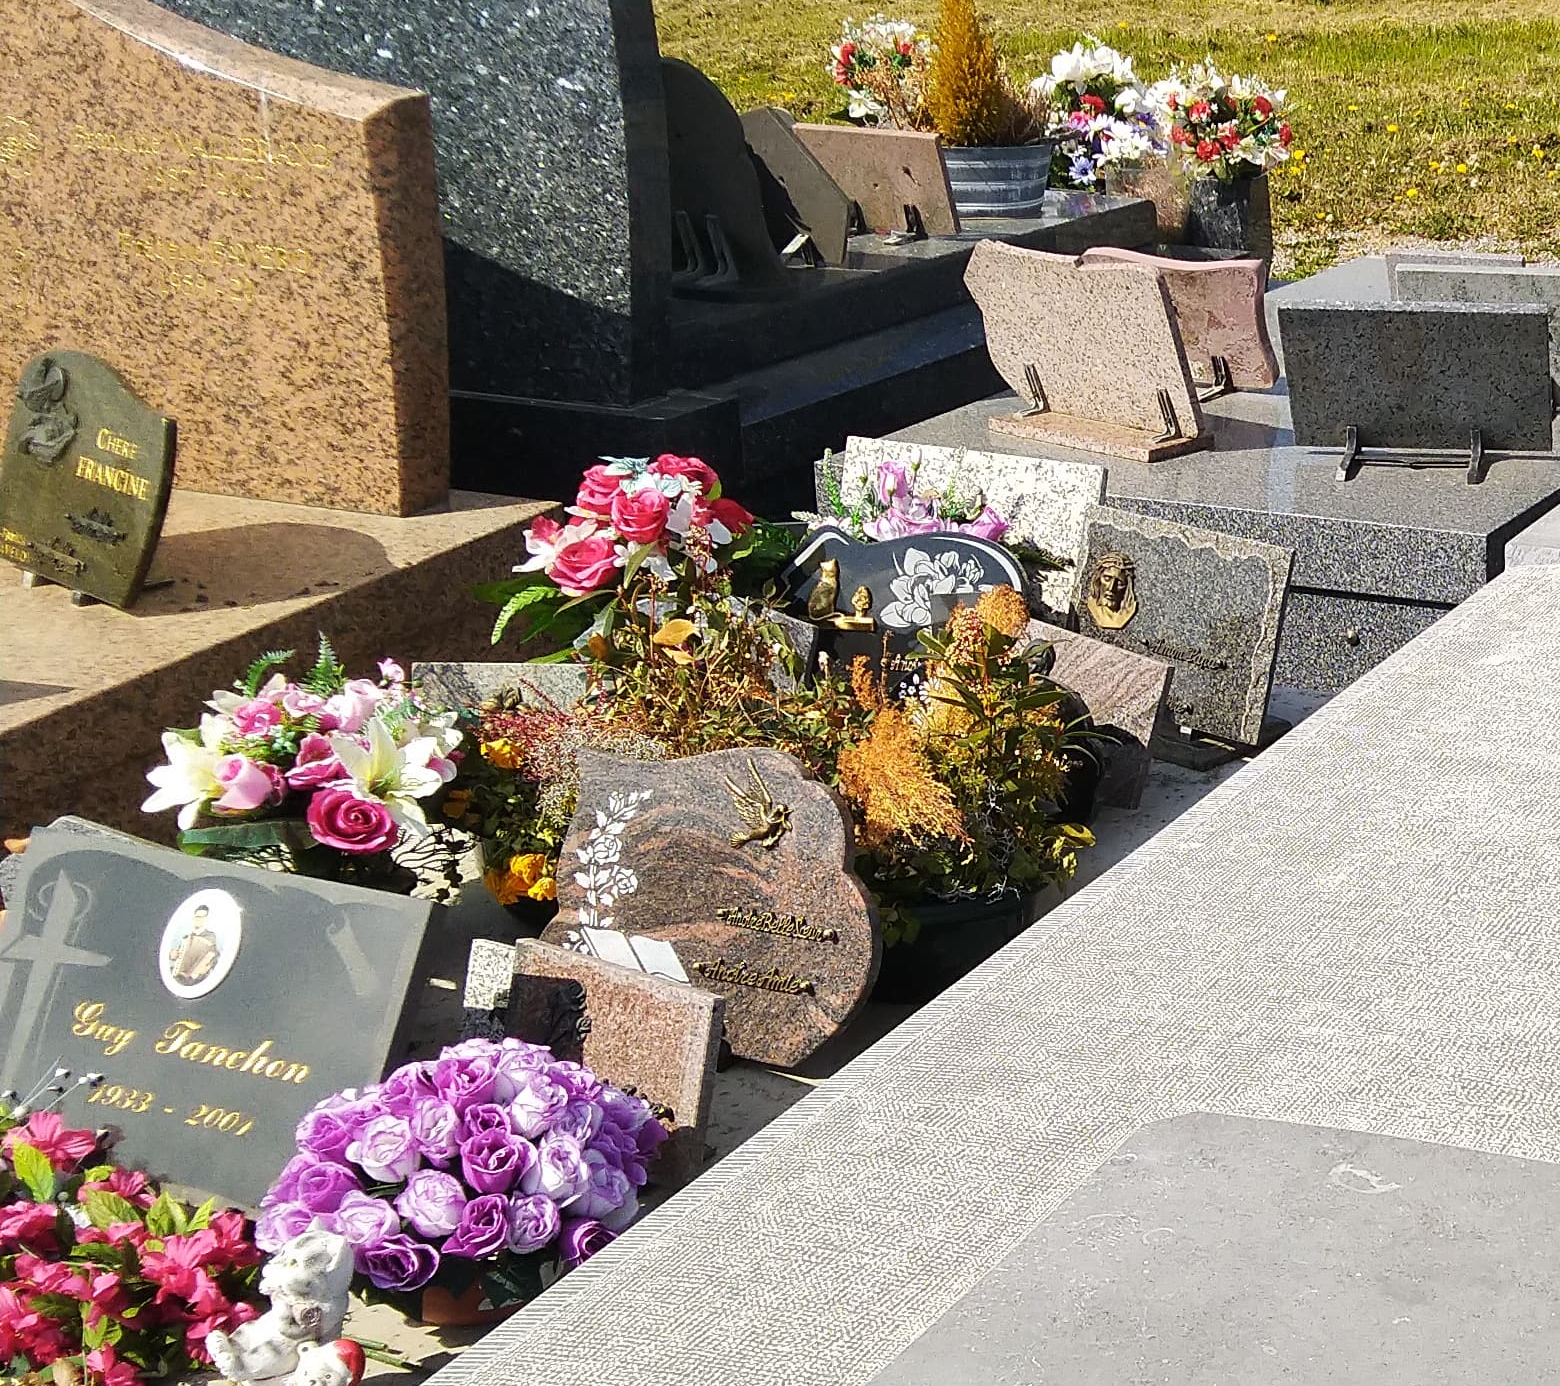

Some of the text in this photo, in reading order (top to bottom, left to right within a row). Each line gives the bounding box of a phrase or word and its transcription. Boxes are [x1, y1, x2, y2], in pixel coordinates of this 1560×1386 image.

[76, 455, 151, 501] FRANCINE
[71, 999, 137, 1056] Guy
[87, 1084, 155, 1113] 1933
[184, 1104, 255, 1136] 2001
